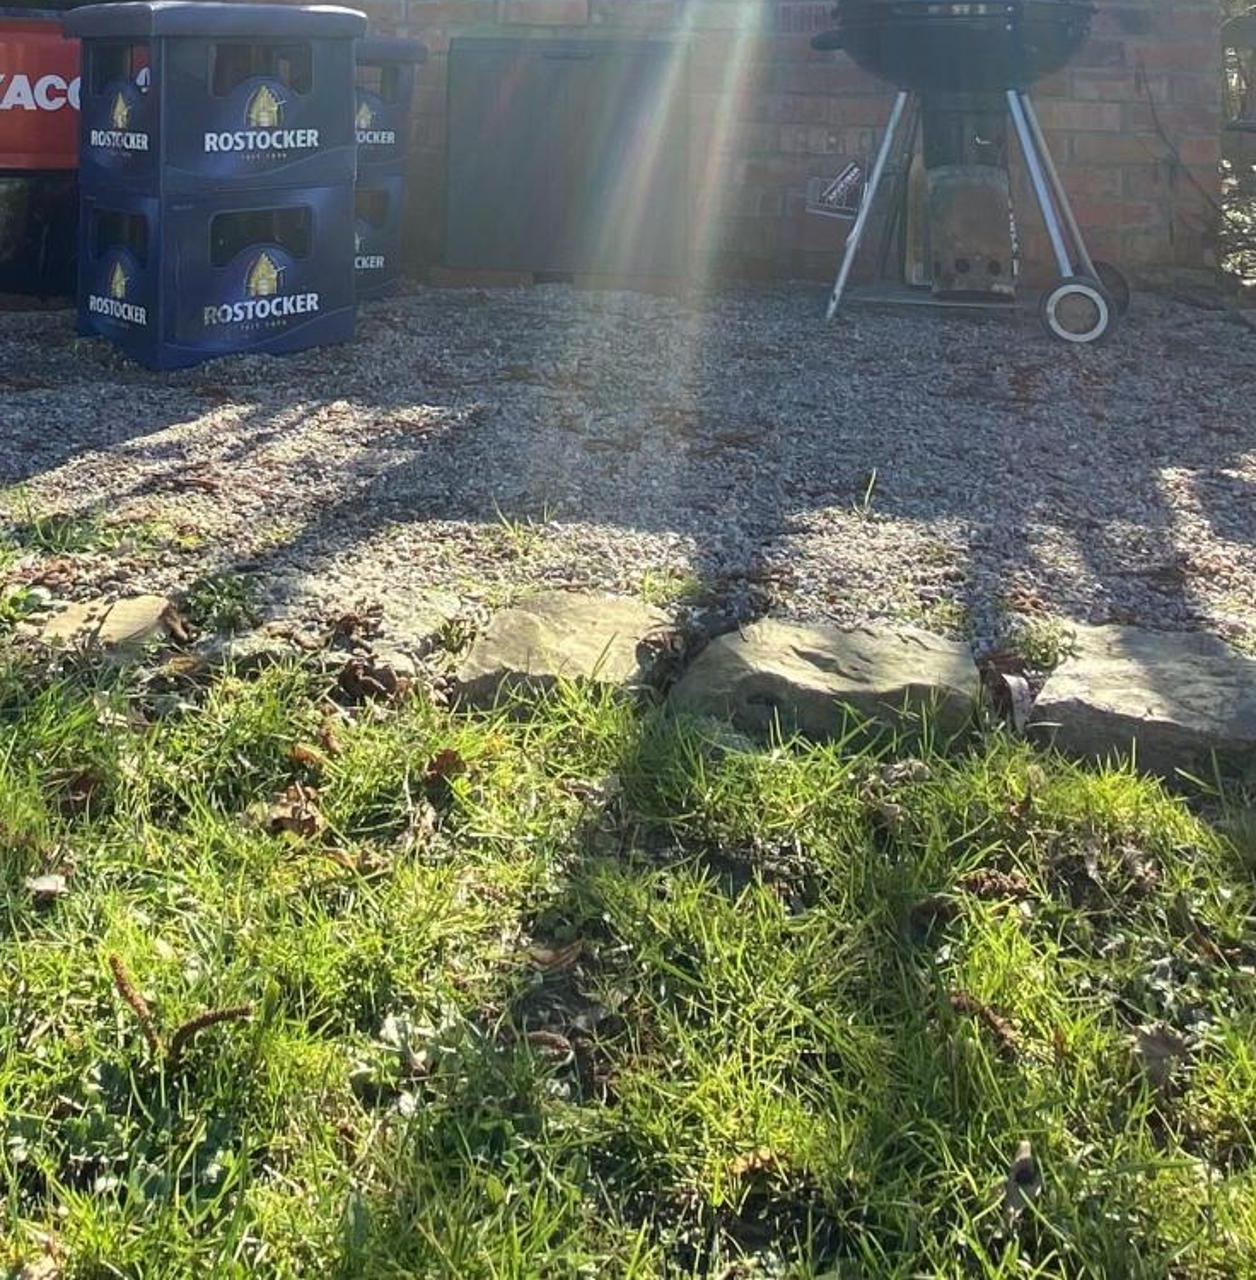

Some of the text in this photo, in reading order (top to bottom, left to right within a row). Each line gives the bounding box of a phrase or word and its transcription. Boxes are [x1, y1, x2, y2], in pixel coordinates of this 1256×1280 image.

[91, 130, 148, 151] ROSTOCKER
[204, 129, 319, 152] ROSTOCKER
[89, 294, 146, 326] ROSTOCKER
[204, 293, 319, 326] ROSTOCKER
